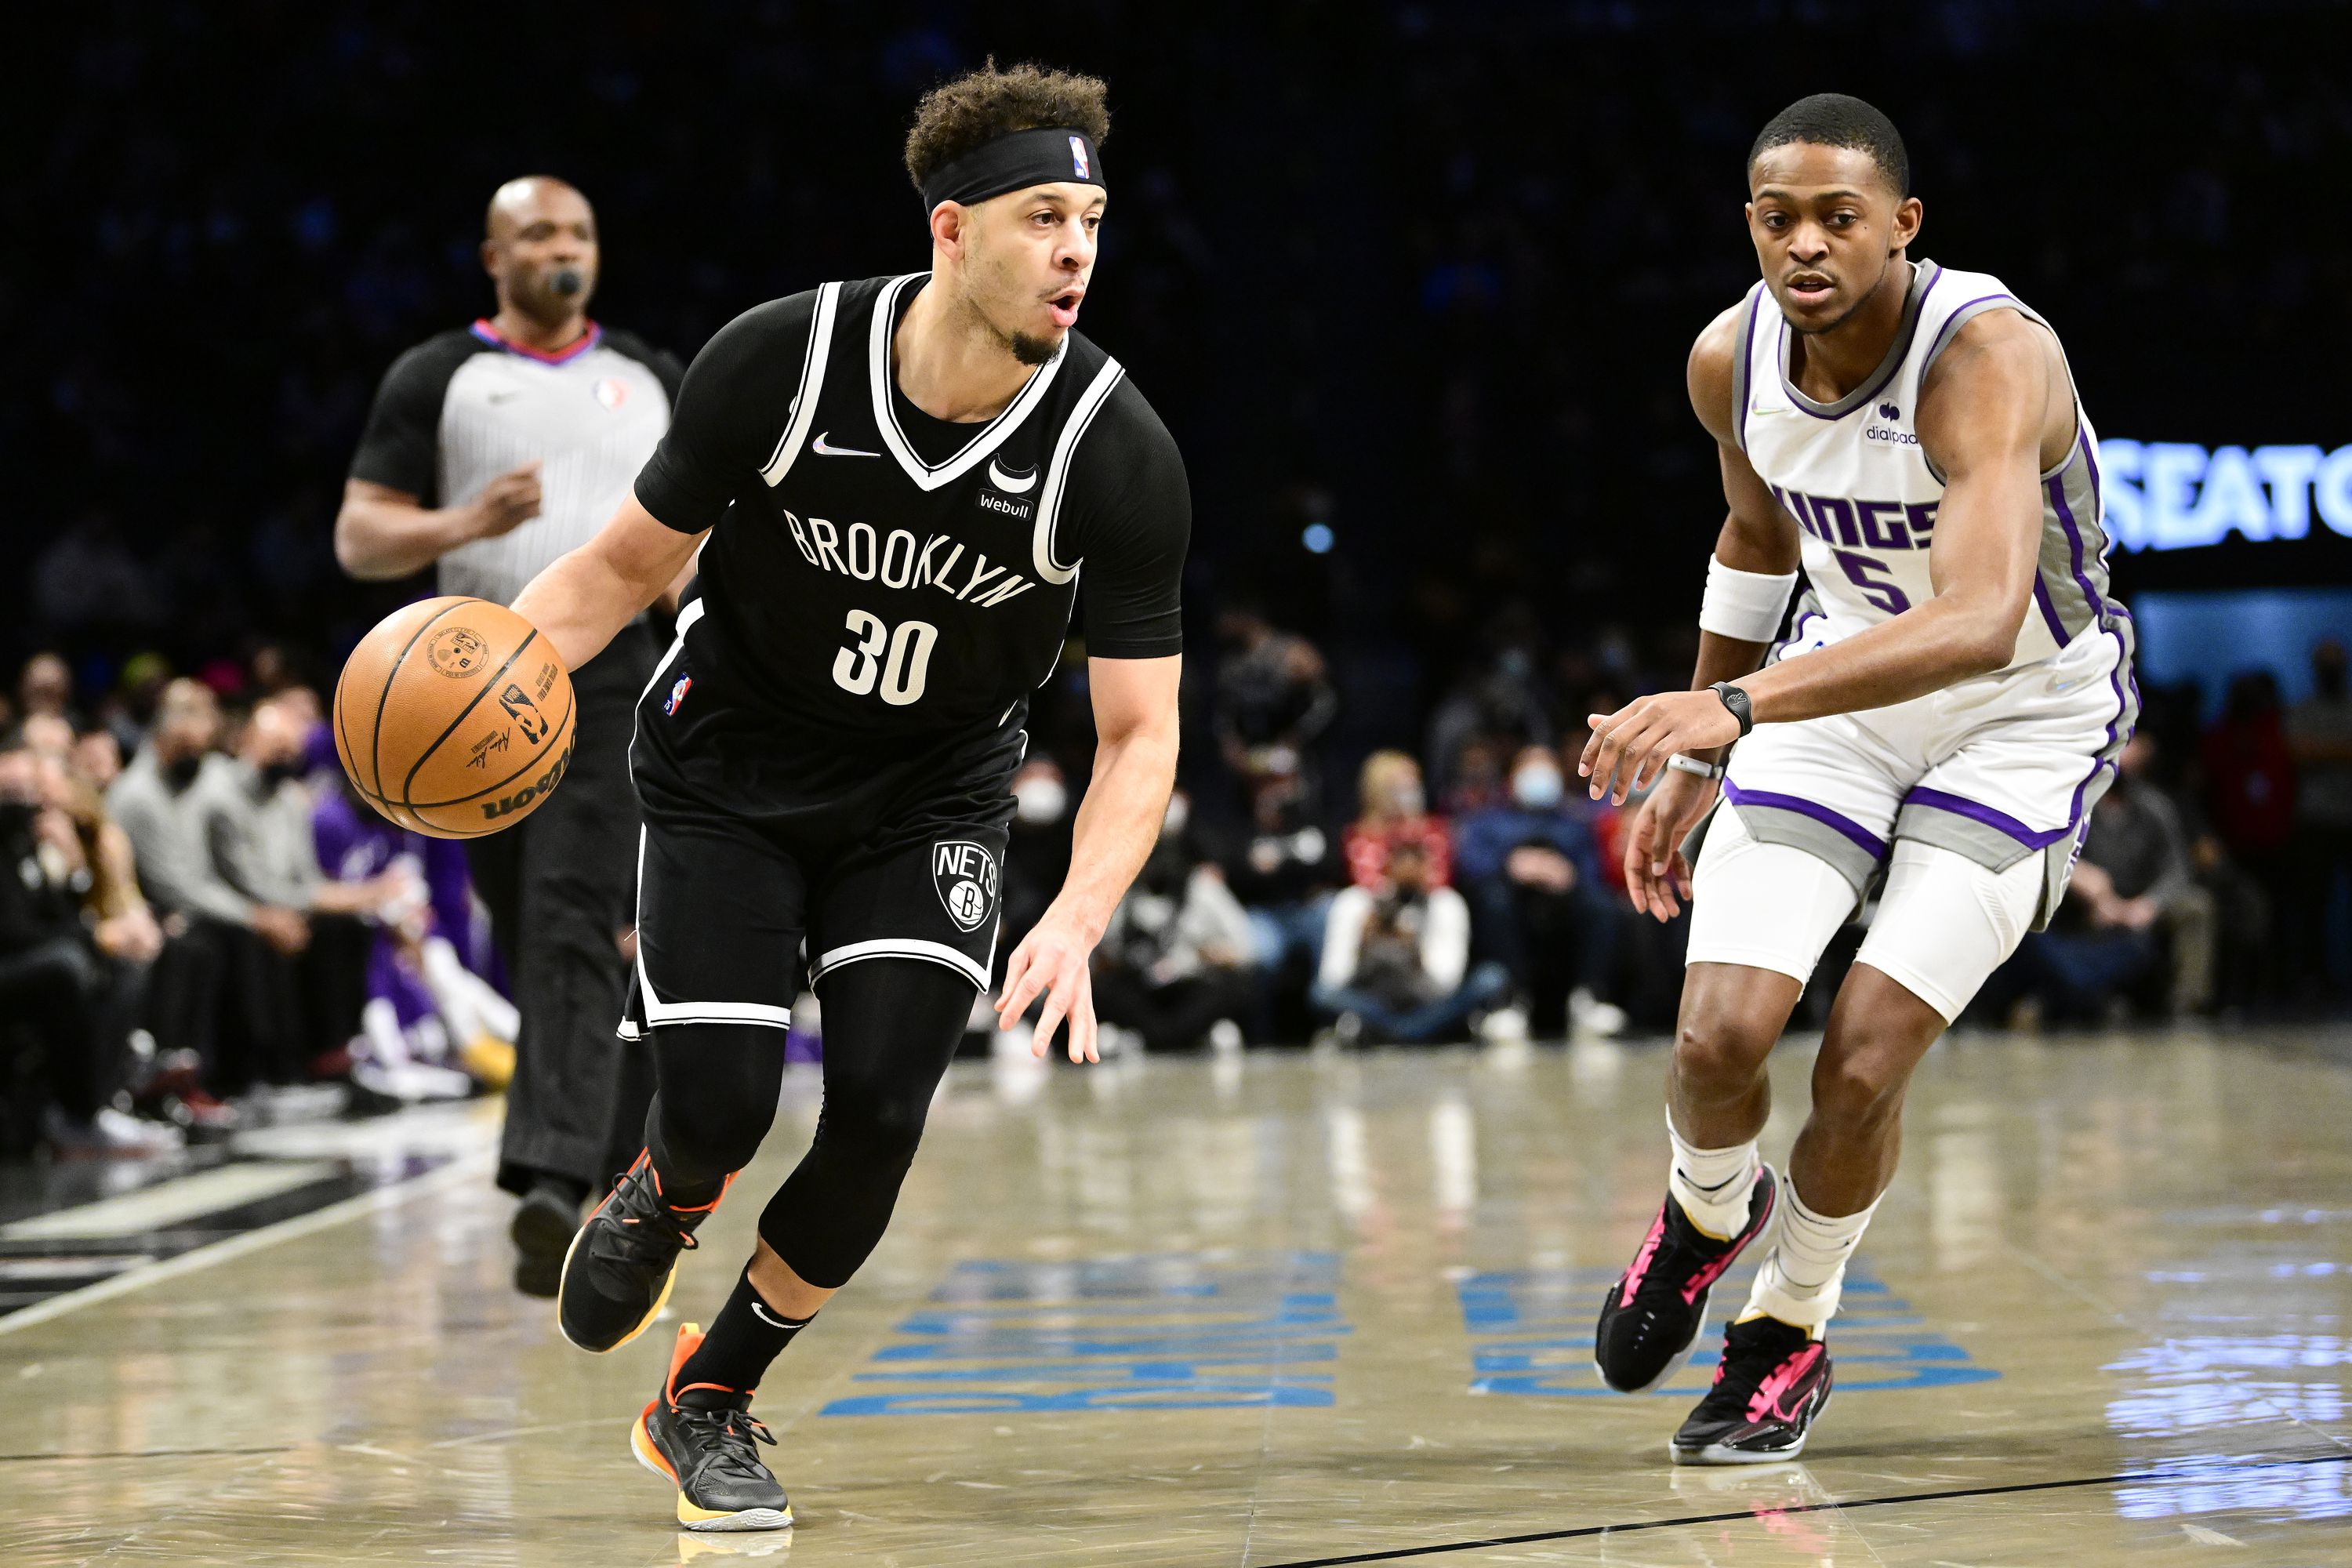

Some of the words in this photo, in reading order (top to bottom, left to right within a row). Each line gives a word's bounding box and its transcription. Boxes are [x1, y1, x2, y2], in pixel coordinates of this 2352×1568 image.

[980, 494, 1029, 518] Webull
[1770, 483, 1941, 550] INGS
[784, 509, 1036, 608] BROOKLYN
[1832, 548, 1911, 615] 5
[833, 609, 938, 706] 30
[481, 727, 577, 819] ilson
[937, 845, 996, 898] NETS
[961, 886, 975, 919] B
[818, 1249, 1355, 1417] BARCL
